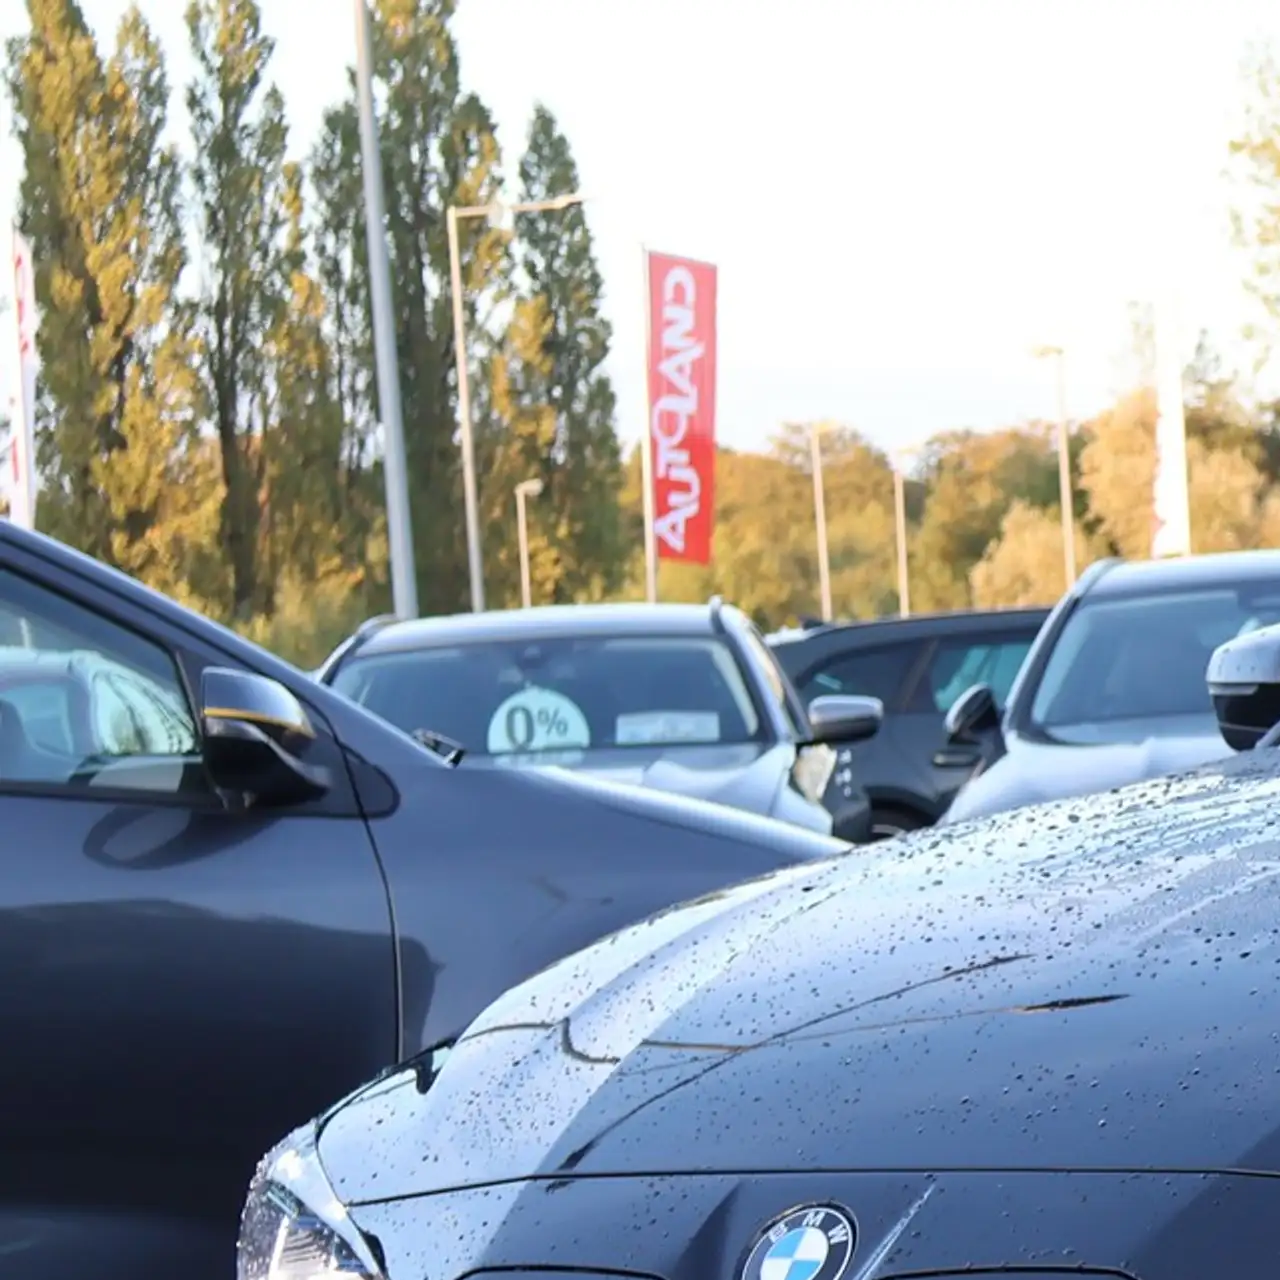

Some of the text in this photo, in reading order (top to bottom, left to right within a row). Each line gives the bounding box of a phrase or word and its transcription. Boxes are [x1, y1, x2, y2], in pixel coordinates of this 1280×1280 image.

[652, 264, 706, 552] AUTOLAND
[506, 705, 569, 752] 0%
[768, 1211, 848, 1245] BMW
